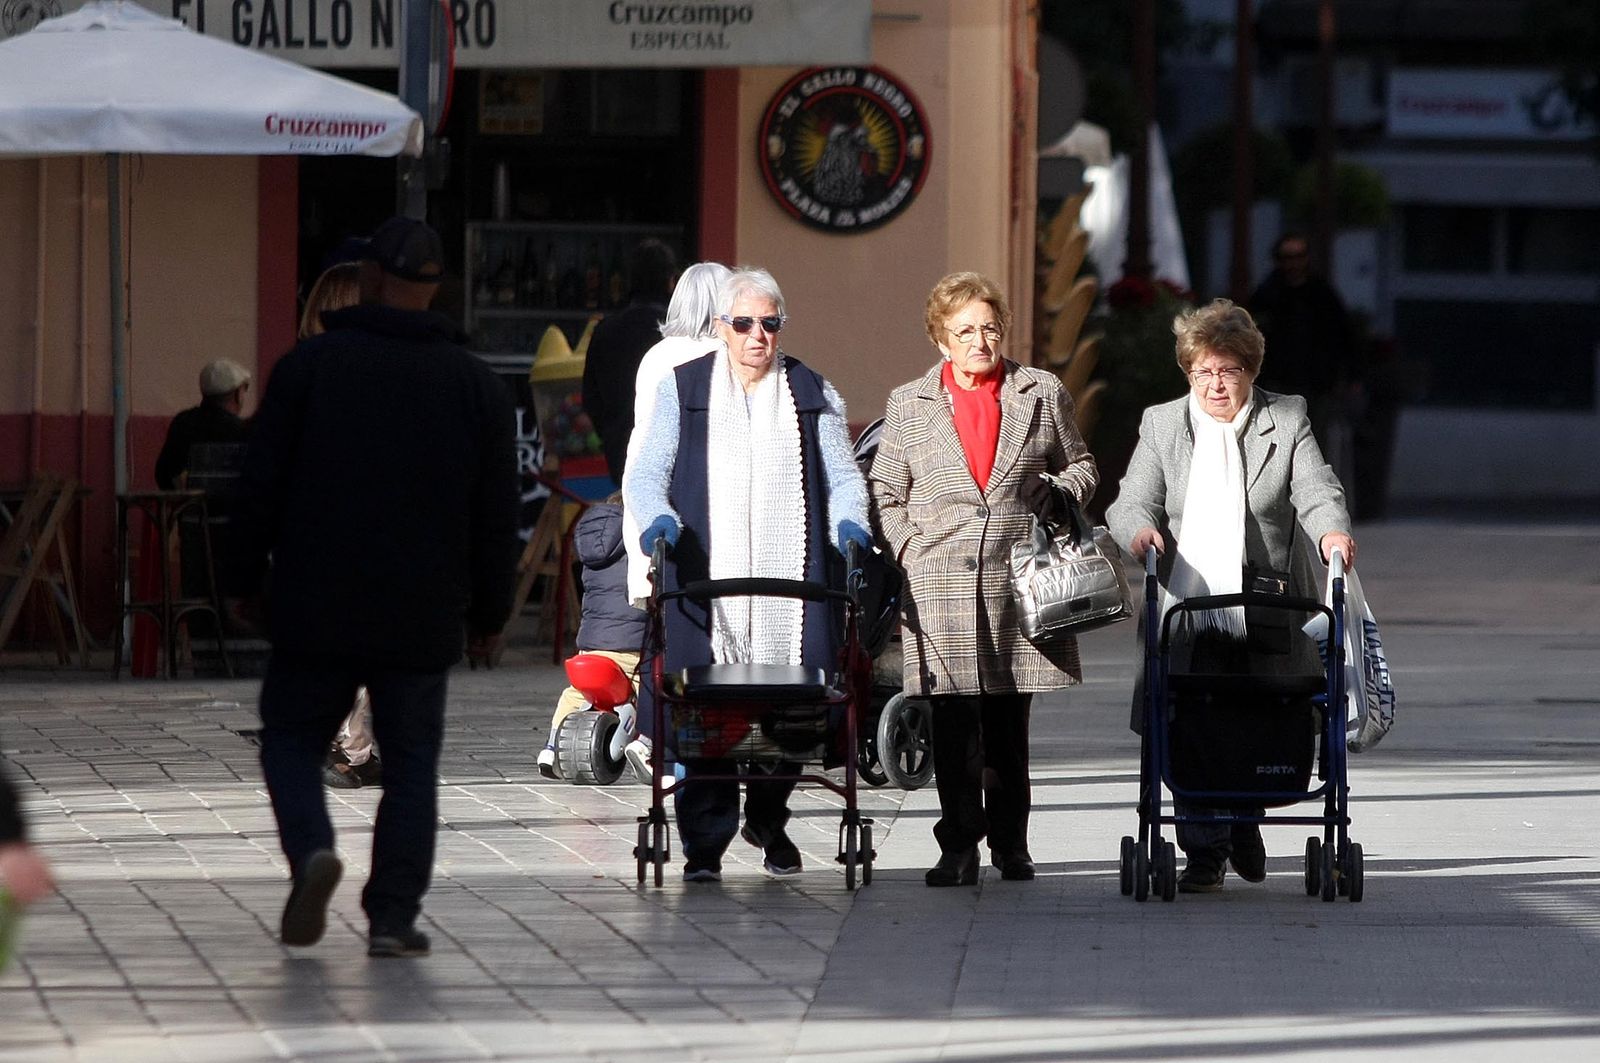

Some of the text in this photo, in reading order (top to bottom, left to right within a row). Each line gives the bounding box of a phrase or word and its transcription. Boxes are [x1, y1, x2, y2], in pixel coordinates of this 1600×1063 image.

[232, 0, 353, 48] GALLO
[370, 0, 496, 48] NRO
[608, 1, 753, 28] Cruzcampo
[629, 31, 732, 50] ESPECIAL
[801, 70, 857, 97] GALLO
[863, 73, 913, 118] NEGRO
[265, 112, 387, 140] Cruzcampo
[1256, 765, 1297, 775] FORTA
